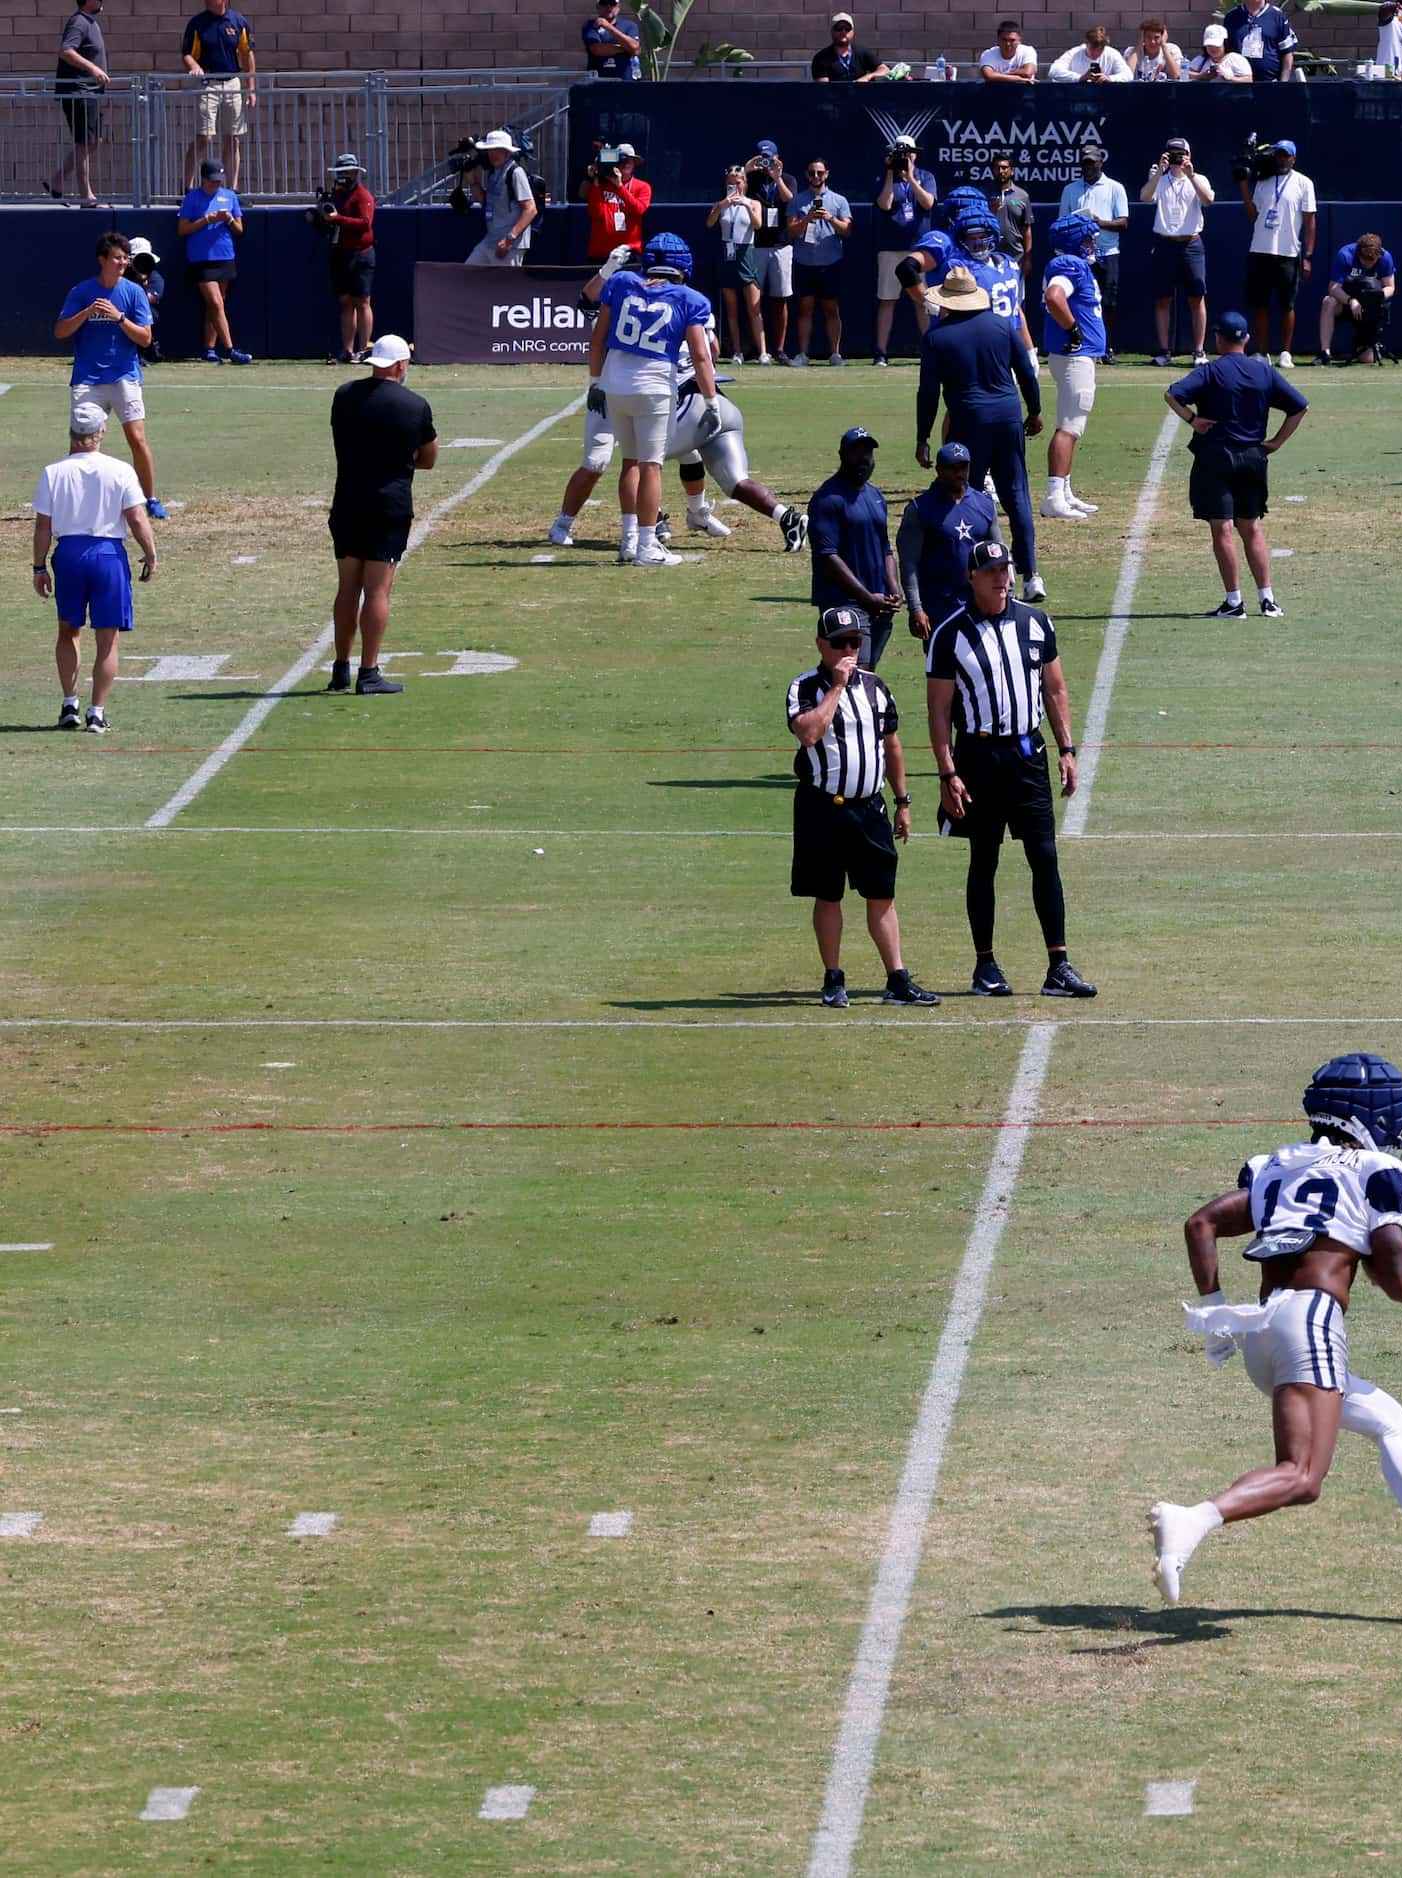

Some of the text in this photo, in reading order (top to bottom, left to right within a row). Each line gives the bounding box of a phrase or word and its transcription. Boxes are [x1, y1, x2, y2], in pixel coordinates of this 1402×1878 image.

[1019, 149, 1032, 164] &
[969, 166, 995, 180] SA
[1013, 166, 1082, 181] MANUE
[615, 295, 674, 354] 62
[491, 342, 509, 352] an
[513, 340, 547, 353] NRG
